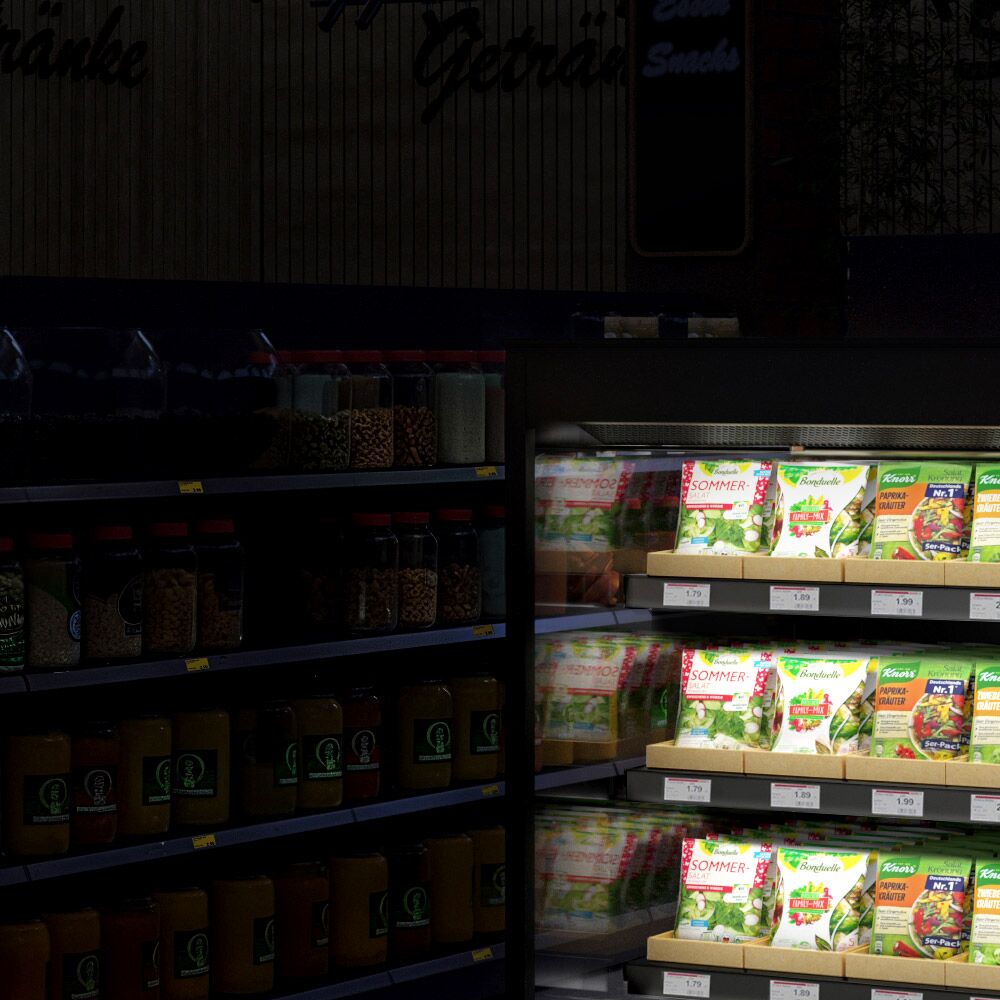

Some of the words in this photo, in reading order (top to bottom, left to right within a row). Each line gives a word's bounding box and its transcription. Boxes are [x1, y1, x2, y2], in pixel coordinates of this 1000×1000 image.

[642, 37, 740, 78] Snacks
[800, 476, 841, 488] Bonduelle
[881, 473, 916, 484] Knorr
[690, 480, 750, 491] SOMMER-
[880, 492, 909, 500] PAPRIKA-
[686, 590, 702, 598] 1.79
[794, 594, 810, 602] 1.89
[896, 598, 913, 606] 1.99
[690, 670, 750, 682] SOMMER-
[800, 670, 841, 680] Bonduelle
[881, 668, 916, 678] Knorr
[880, 687, 909, 695] PAPRIKA-
[687, 784, 702, 792] 1.79
[794, 790, 811, 798] 1.89
[897, 798, 914, 806] 1.99
[690, 860, 750, 873] SOMMER-
[800, 862, 841, 873] Bonduelle
[881, 862, 916, 874] Knorr
[880, 882, 909, 890] PAPRIKA-
[686, 980, 702, 988] 1.79
[794, 988, 810, 996] 1.89
